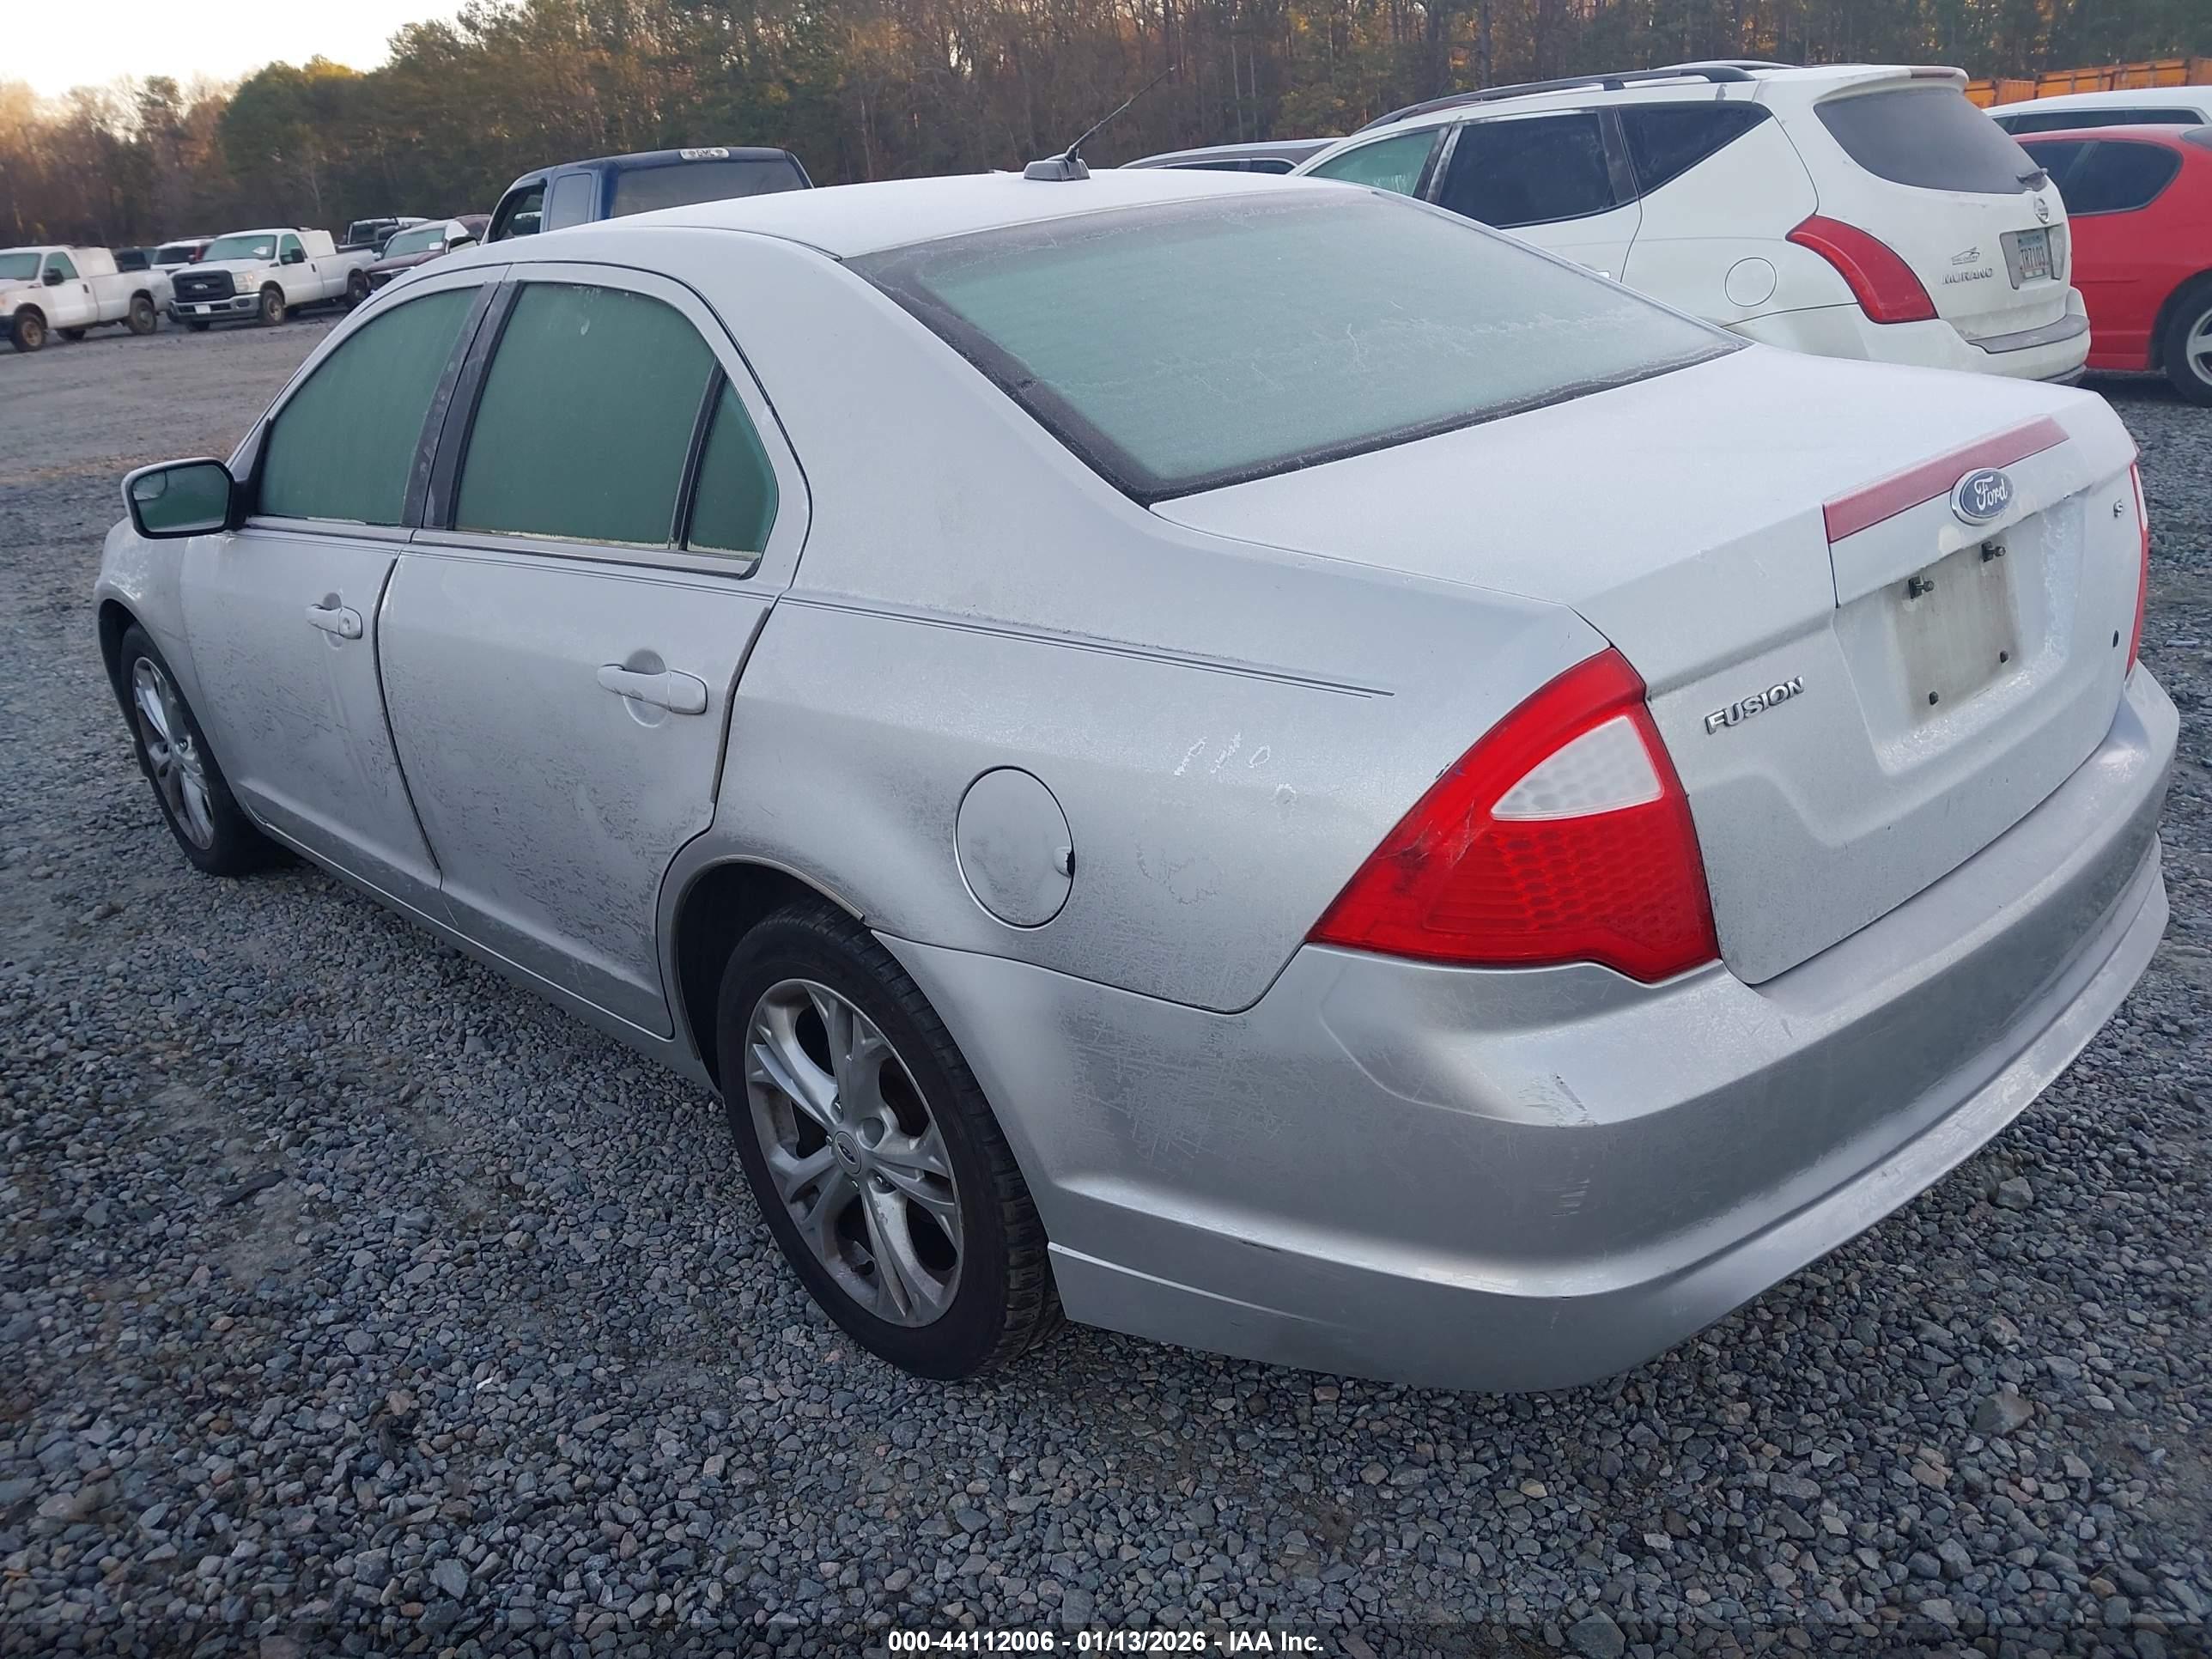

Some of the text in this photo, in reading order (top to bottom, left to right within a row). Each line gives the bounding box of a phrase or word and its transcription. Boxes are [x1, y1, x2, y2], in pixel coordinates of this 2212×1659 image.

[1942, 267, 1993, 284] MURANO
[1974, 475, 2008, 510] Ford
[1705, 675, 1804, 735] FUSION
